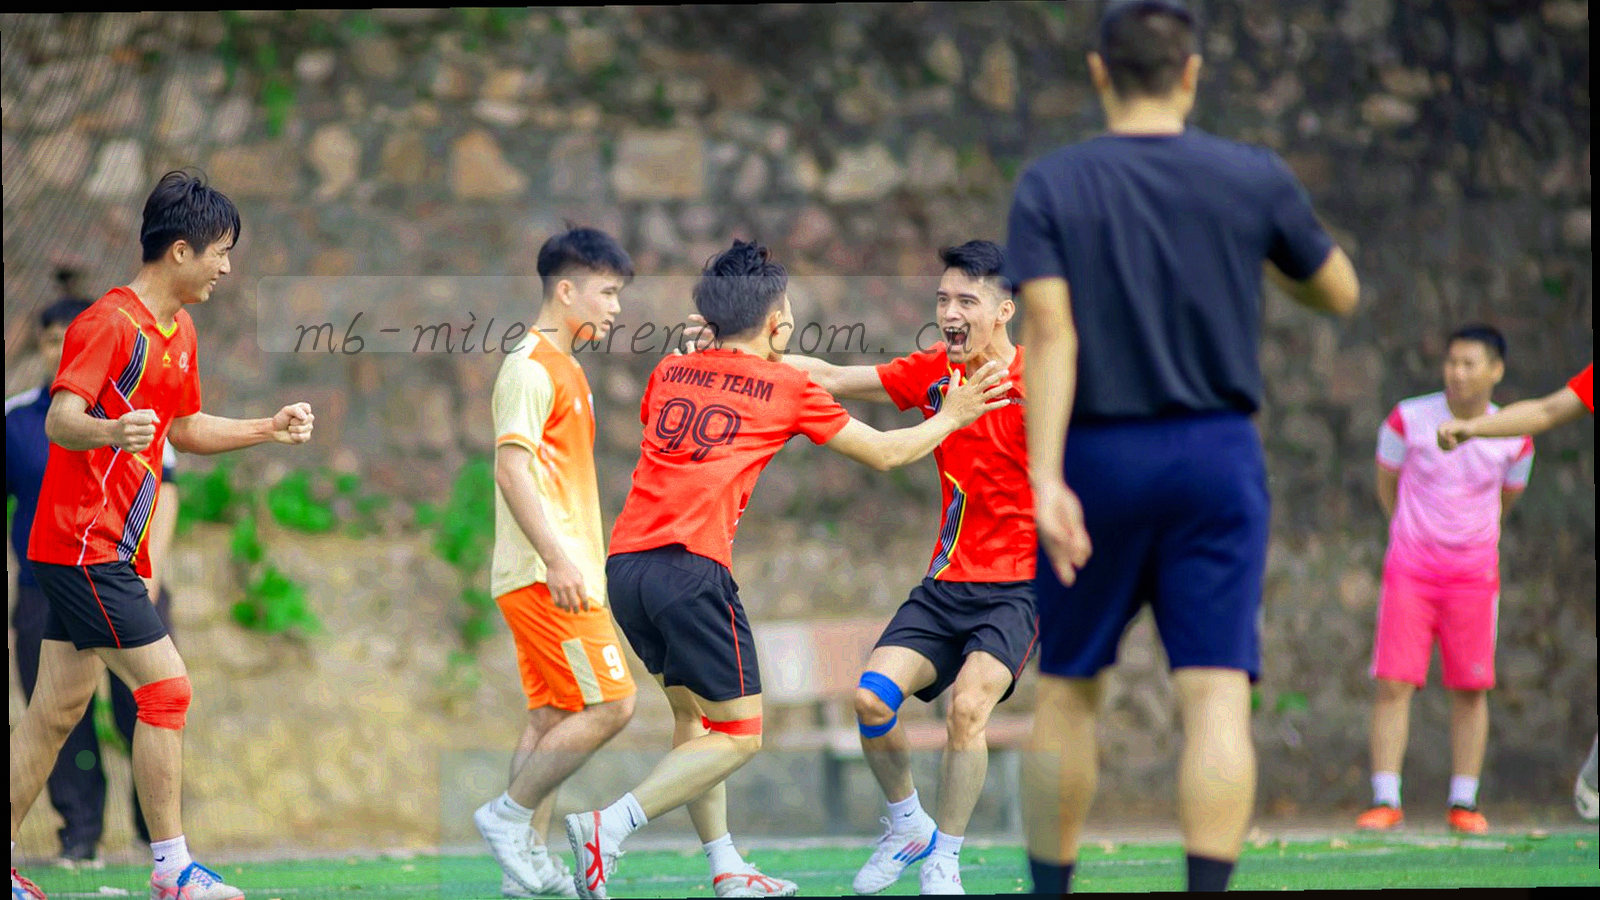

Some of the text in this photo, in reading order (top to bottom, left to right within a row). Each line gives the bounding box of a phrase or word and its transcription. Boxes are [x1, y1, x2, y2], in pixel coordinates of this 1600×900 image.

[662, 366, 774, 402] SWINE TEAM
[654, 397, 741, 461] 99
[602, 644, 625, 680] 9
